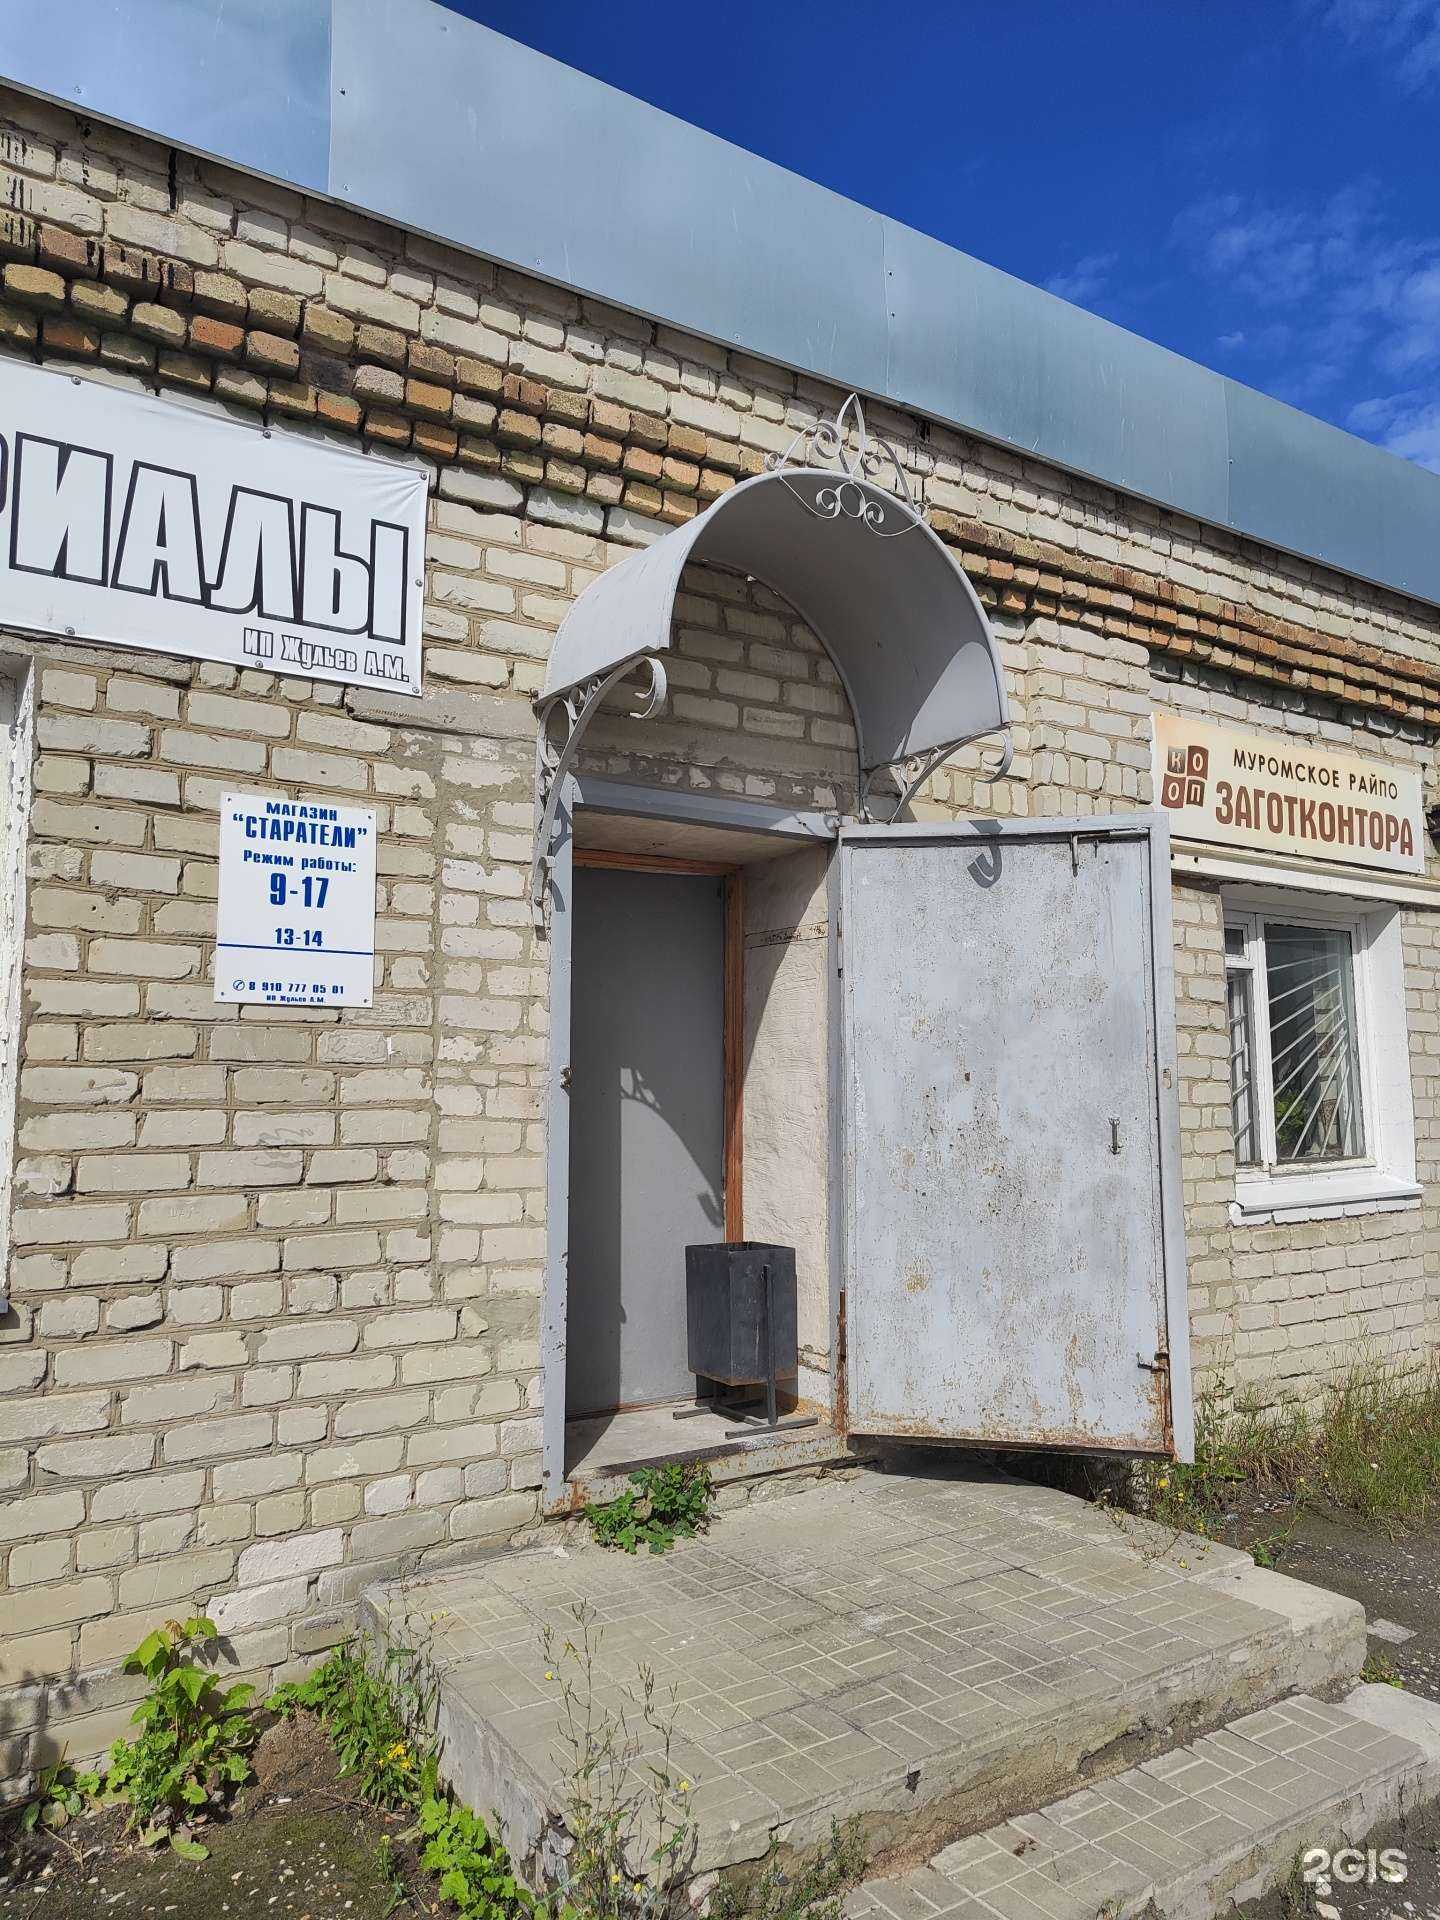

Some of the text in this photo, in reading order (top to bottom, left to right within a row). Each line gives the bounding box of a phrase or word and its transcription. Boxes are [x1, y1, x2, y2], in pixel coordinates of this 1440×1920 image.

[0, 431, 409, 645] ИАЛЫ
[243, 627, 410, 683] ИП Жульев А.М.
[1233, 749, 1399, 800] МУРОМСКОЕ РАЙПО
[266, 802, 338, 821] МАГАЗИН
[1215, 781, 1414, 857] ЗАГОТКОНТОРА
[243, 849, 357, 872] Режим работы:
[269, 872, 330, 909] 9-17
[274, 927, 323, 947] 13-14
[248, 981, 344, 995] 8 910 777 05 01
